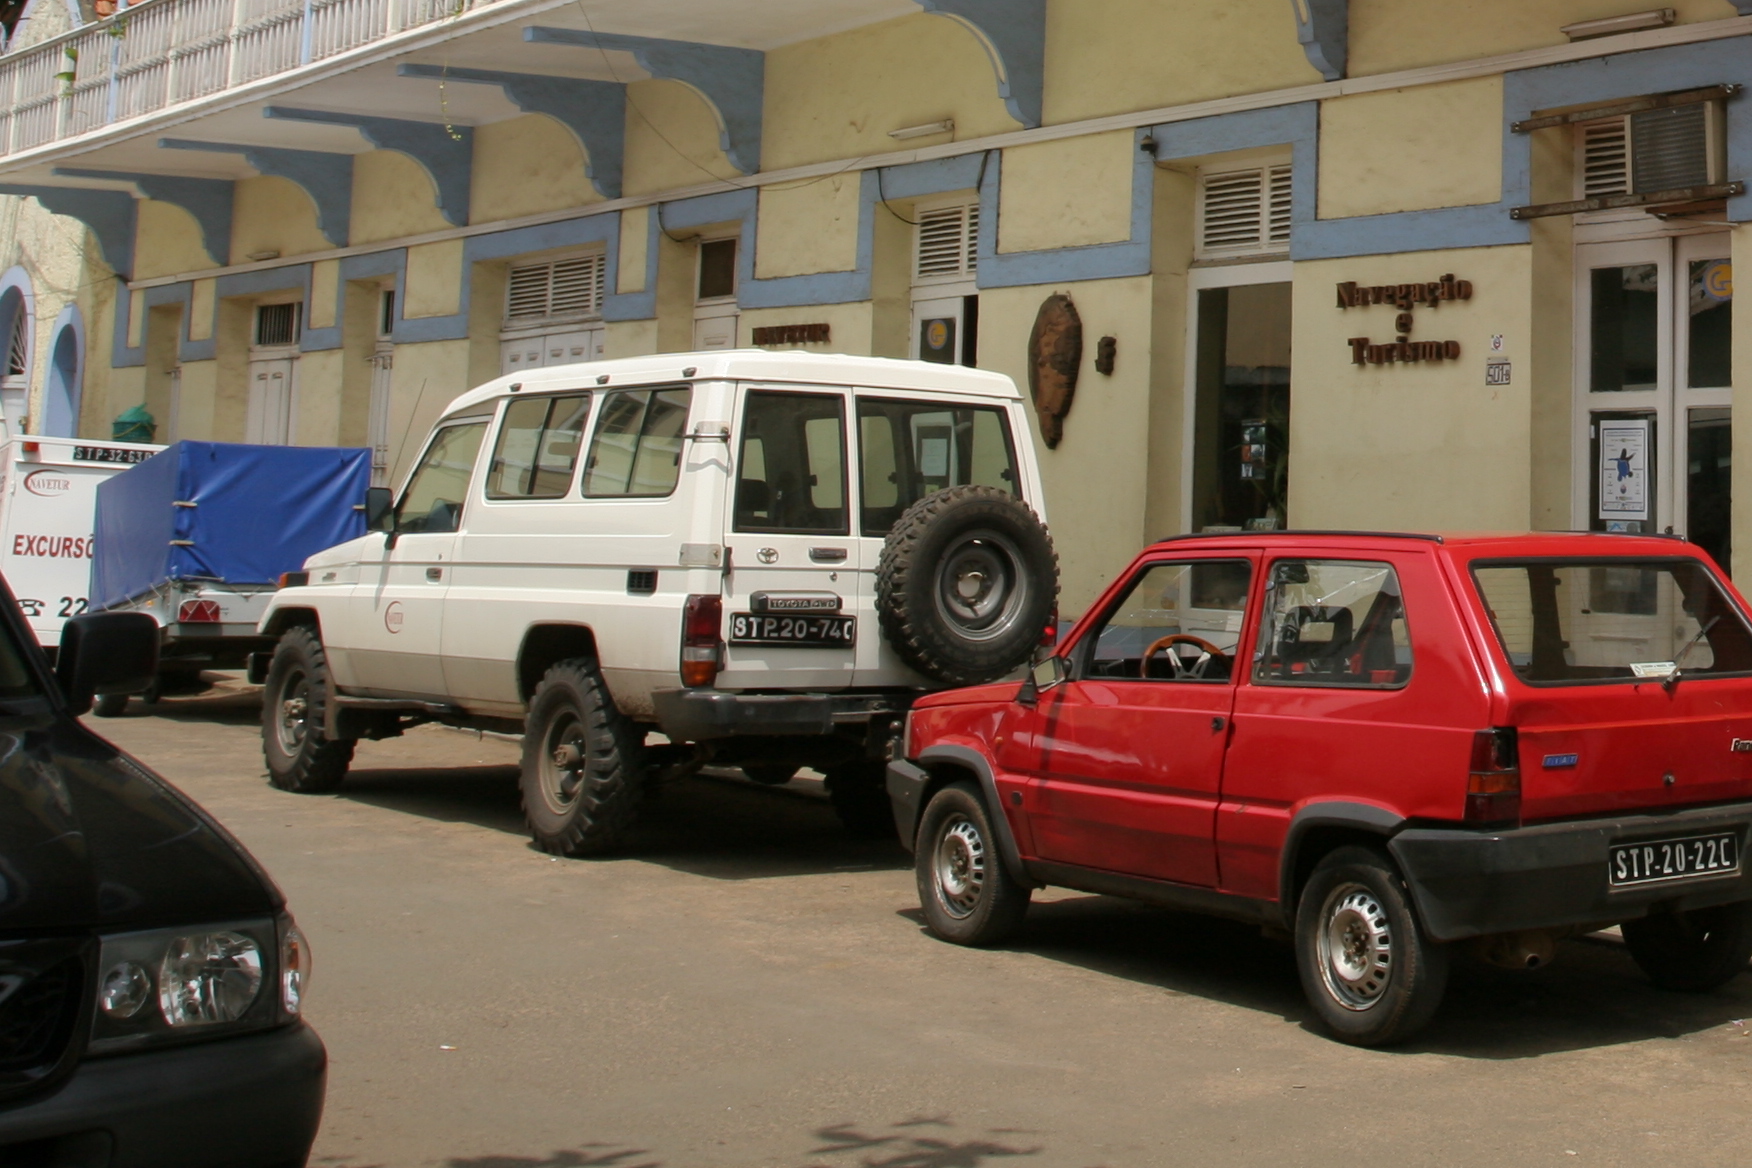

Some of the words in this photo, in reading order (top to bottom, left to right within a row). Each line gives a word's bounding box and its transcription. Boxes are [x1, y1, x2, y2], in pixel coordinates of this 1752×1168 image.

[1336, 273, 1473, 310] Navegação
[1395, 313, 1413, 333] e
[1348, 335, 1461, 365] Turismo
[29, 478, 70, 490] NAVETUR
[771, 599, 809, 608] TOYOTA
